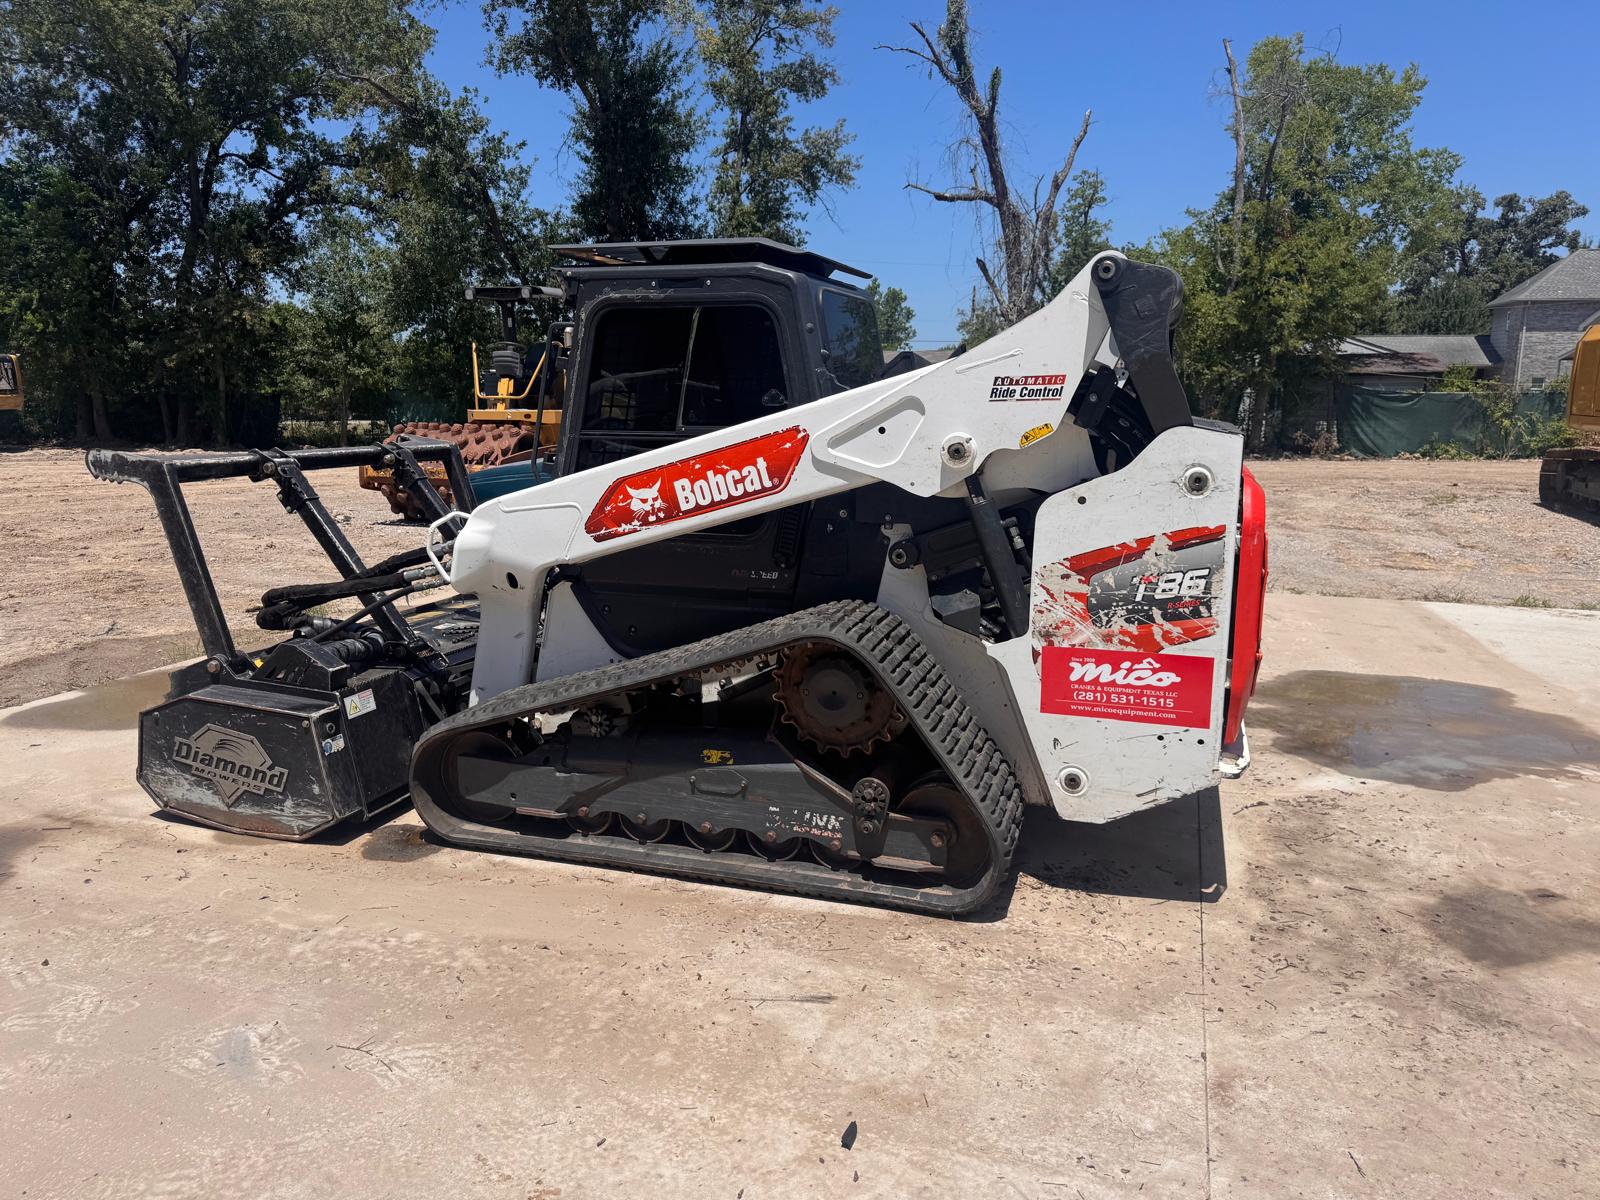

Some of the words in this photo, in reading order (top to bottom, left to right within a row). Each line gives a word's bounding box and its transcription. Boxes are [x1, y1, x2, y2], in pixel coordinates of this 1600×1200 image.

[995, 376, 1064, 386] AUTOMATIC
[989, 387, 1016, 398] Ride
[1019, 386, 1064, 398] Control
[673, 456, 773, 512] Bobcat
[1070, 683, 1096, 691] CRANES
[1103, 686, 1141, 694] EQUIPMENT
[1143, 689, 1164, 697] TEXAS
[1073, 690, 1107, 703] (281)
[1110, 693, 1175, 708] 531-1515
[1070, 704, 1177, 719] www.micoequipment.com
[175, 741, 285, 788] Diamond
[194, 766, 262, 791] MOWERS
